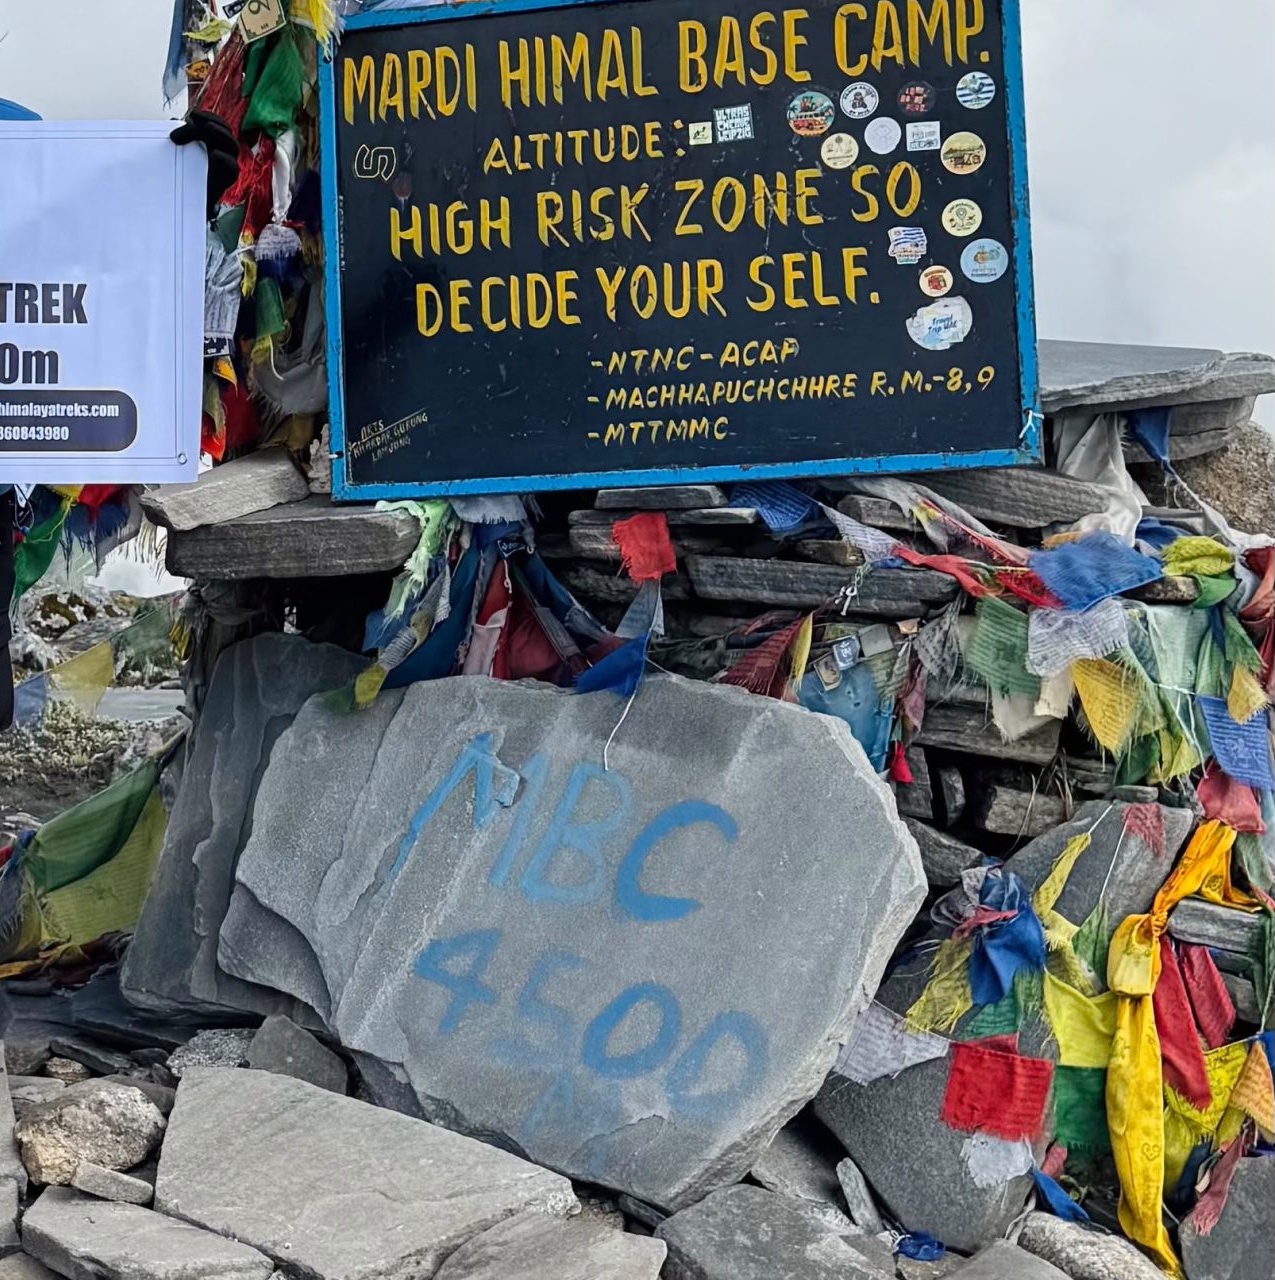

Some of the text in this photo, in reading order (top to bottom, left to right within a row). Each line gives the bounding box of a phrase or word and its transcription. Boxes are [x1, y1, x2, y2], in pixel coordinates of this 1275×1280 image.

[343, 42, 477, 126] MARDI
[499, 25, 660, 111] HIMAL
[678, 8, 812, 93] BASE
[483, 120, 686, 175] ALTITUDE:
[390, 195, 511, 261] HIGH
[536, 182, 652, 248] RISK
[674, 168, 824, 236] ZONE
[851, 160, 922, 223] SO
[416, 246, 881, 337] DECIDE YOUR SELF.
[390, 732, 738, 922] MBC
[414, 928, 770, 1118] 4500
